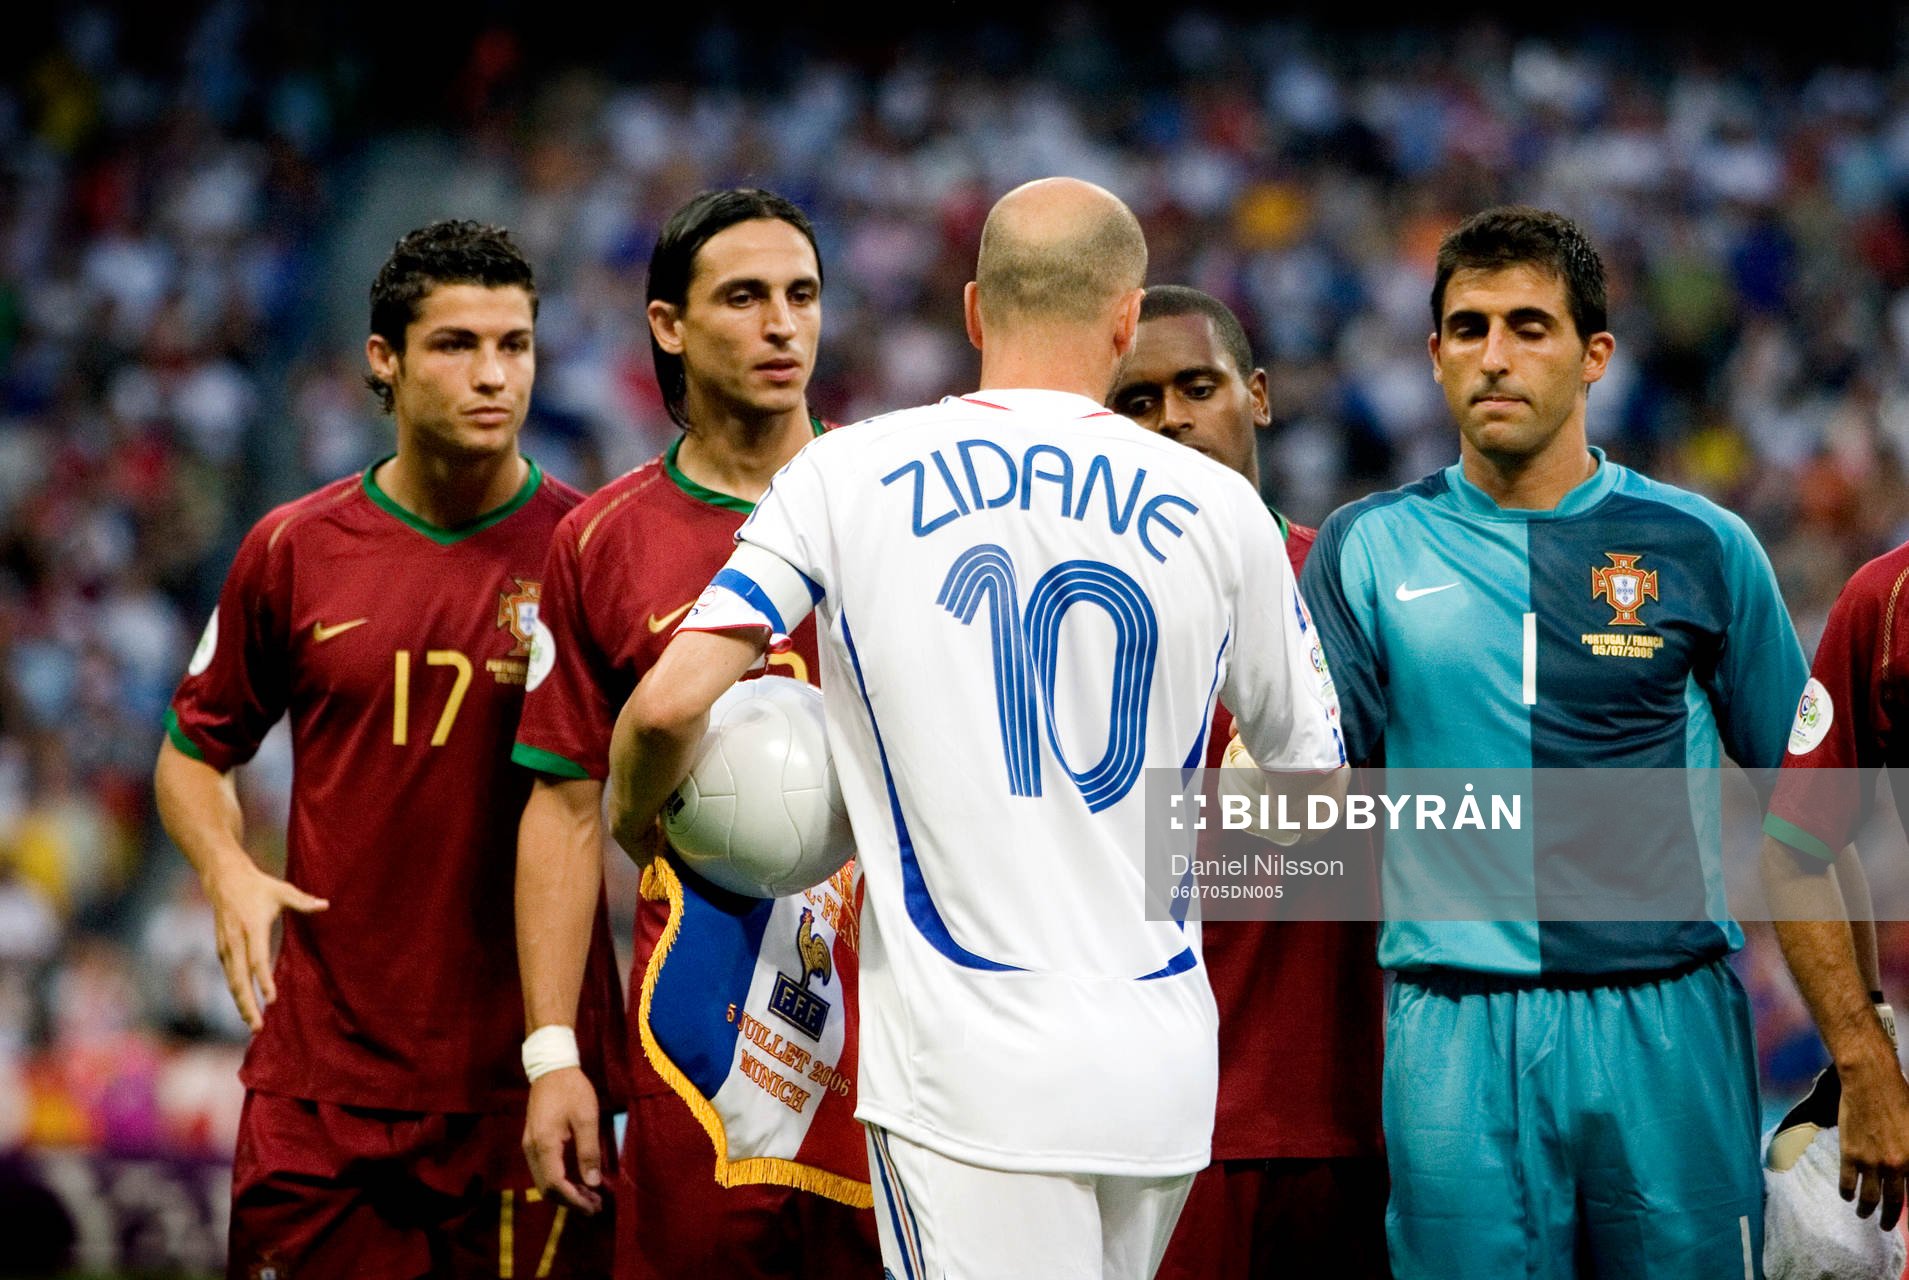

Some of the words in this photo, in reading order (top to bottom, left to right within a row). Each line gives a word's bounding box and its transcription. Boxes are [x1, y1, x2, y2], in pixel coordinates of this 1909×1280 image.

[880, 439, 1199, 565] ZIDANE
[935, 543, 1158, 815] 10
[1581, 634, 1626, 646] PORTUGAL
[1592, 645, 1654, 659] 05/07/2006
[393, 650, 473, 746] 17
[726, 1003, 737, 1023] 5
[737, 1012, 811, 1073] JUILLET
[808, 1060, 851, 1097] 2006
[740, 1049, 811, 1114] MUNICH
